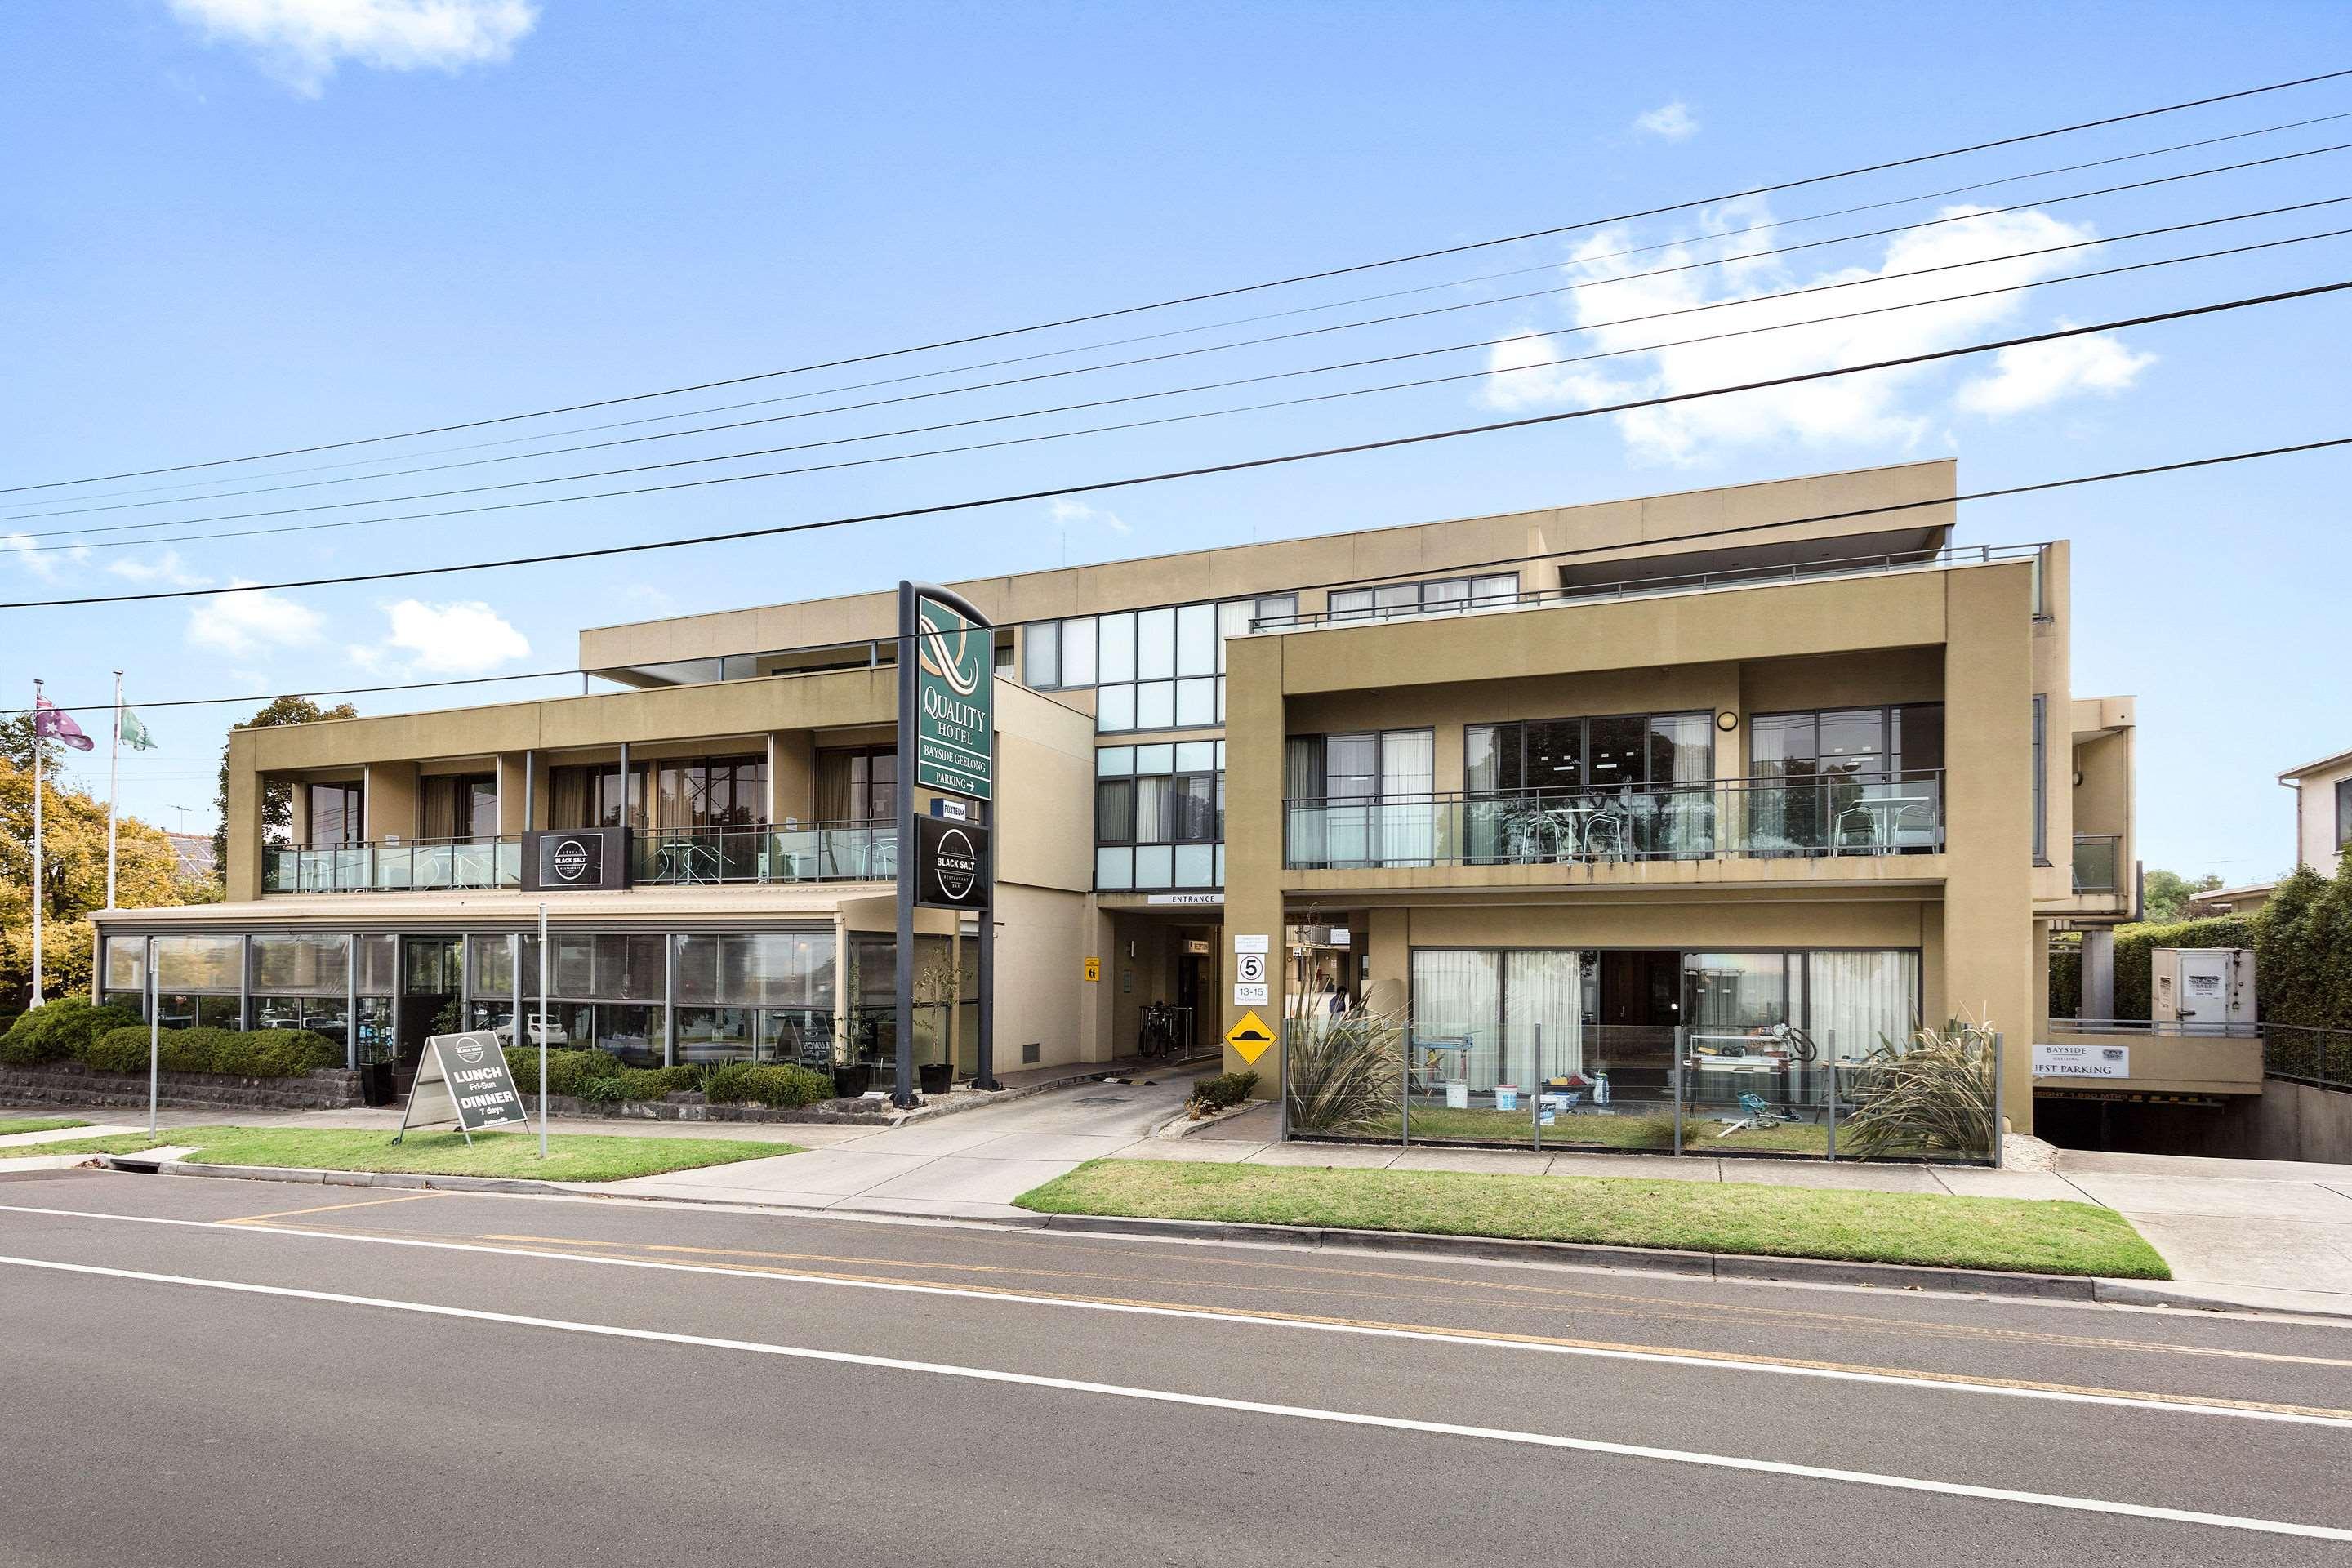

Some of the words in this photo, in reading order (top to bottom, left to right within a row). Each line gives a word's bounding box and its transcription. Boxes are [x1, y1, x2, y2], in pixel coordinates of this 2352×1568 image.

[924, 685, 986, 733] QUALITY
[938, 721, 973, 745] HOTEL
[924, 744, 954, 763] BAYSIDE
[954, 754, 986, 773] GEELONG
[936, 771, 966, 789] PARKING
[944, 804, 960, 816] FOXTEL
[937, 857, 959, 869] BLACK
[960, 861, 975, 871] SALT
[1245, 960, 1257, 976] 5
[1240, 987, 1263, 996] 13-15
[2047, 1046, 2087, 1054] BAYSIDE
[453, 1066, 503, 1083] LUNCH
[2061, 1065, 2111, 1075] PARKING
[469, 1081, 497, 1091] Fri-Sun
[461, 1091, 514, 1109] DINNER
[487, 1105, 504, 1115] days
